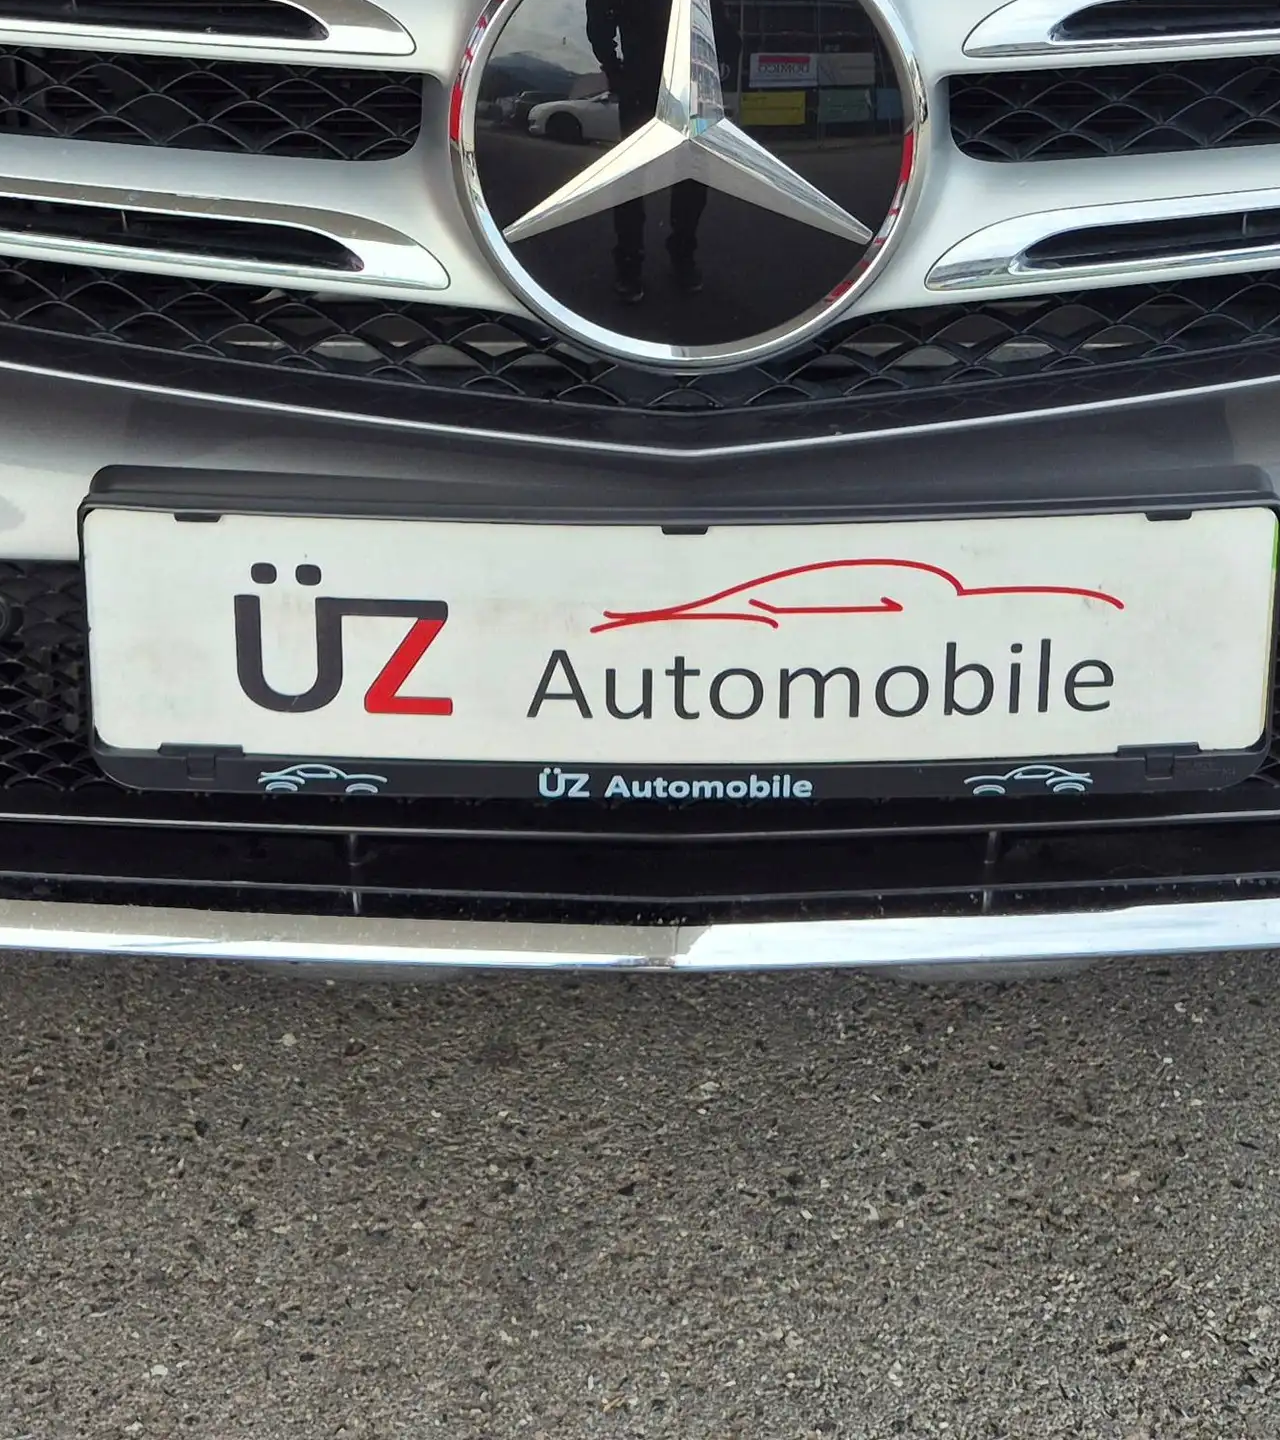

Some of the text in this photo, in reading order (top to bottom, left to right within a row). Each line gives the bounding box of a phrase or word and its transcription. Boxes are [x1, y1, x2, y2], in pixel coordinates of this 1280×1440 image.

[234, 561, 453, 716] ÜZ
[526, 638, 1114, 721] Automobile
[538, 767, 813, 800] ÜZ Automobile
